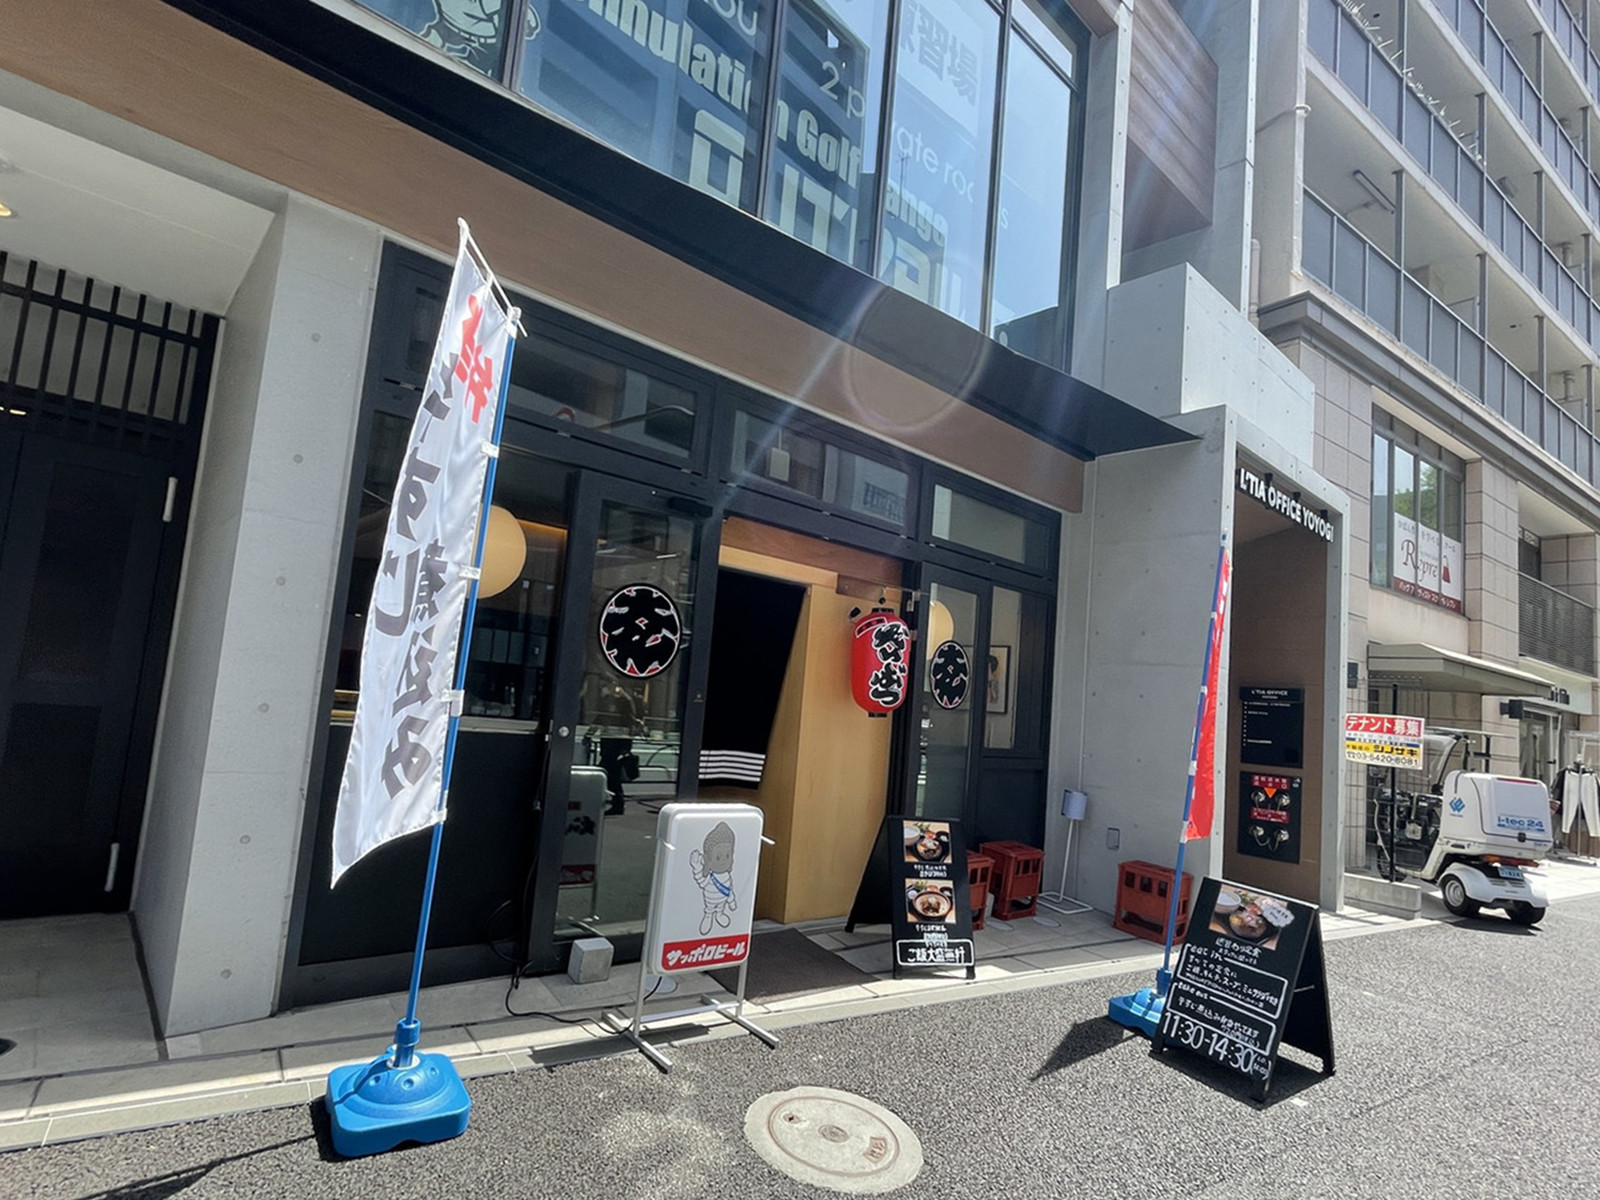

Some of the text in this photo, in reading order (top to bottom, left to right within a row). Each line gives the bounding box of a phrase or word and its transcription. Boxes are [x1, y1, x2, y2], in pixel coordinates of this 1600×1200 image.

[796, 108, 861, 190] Golf
[885, 178, 948, 248] ange
[1267, 486, 1302, 524] OFFICE
[1302, 506, 1334, 543] YOYOGI
[1347, 716, 1420, 737] テナント募集
[1527, 819, 1544, 828] 24
[666, 941, 746, 967] サッポロビール
[1190, 944, 1222, 961] eat in
